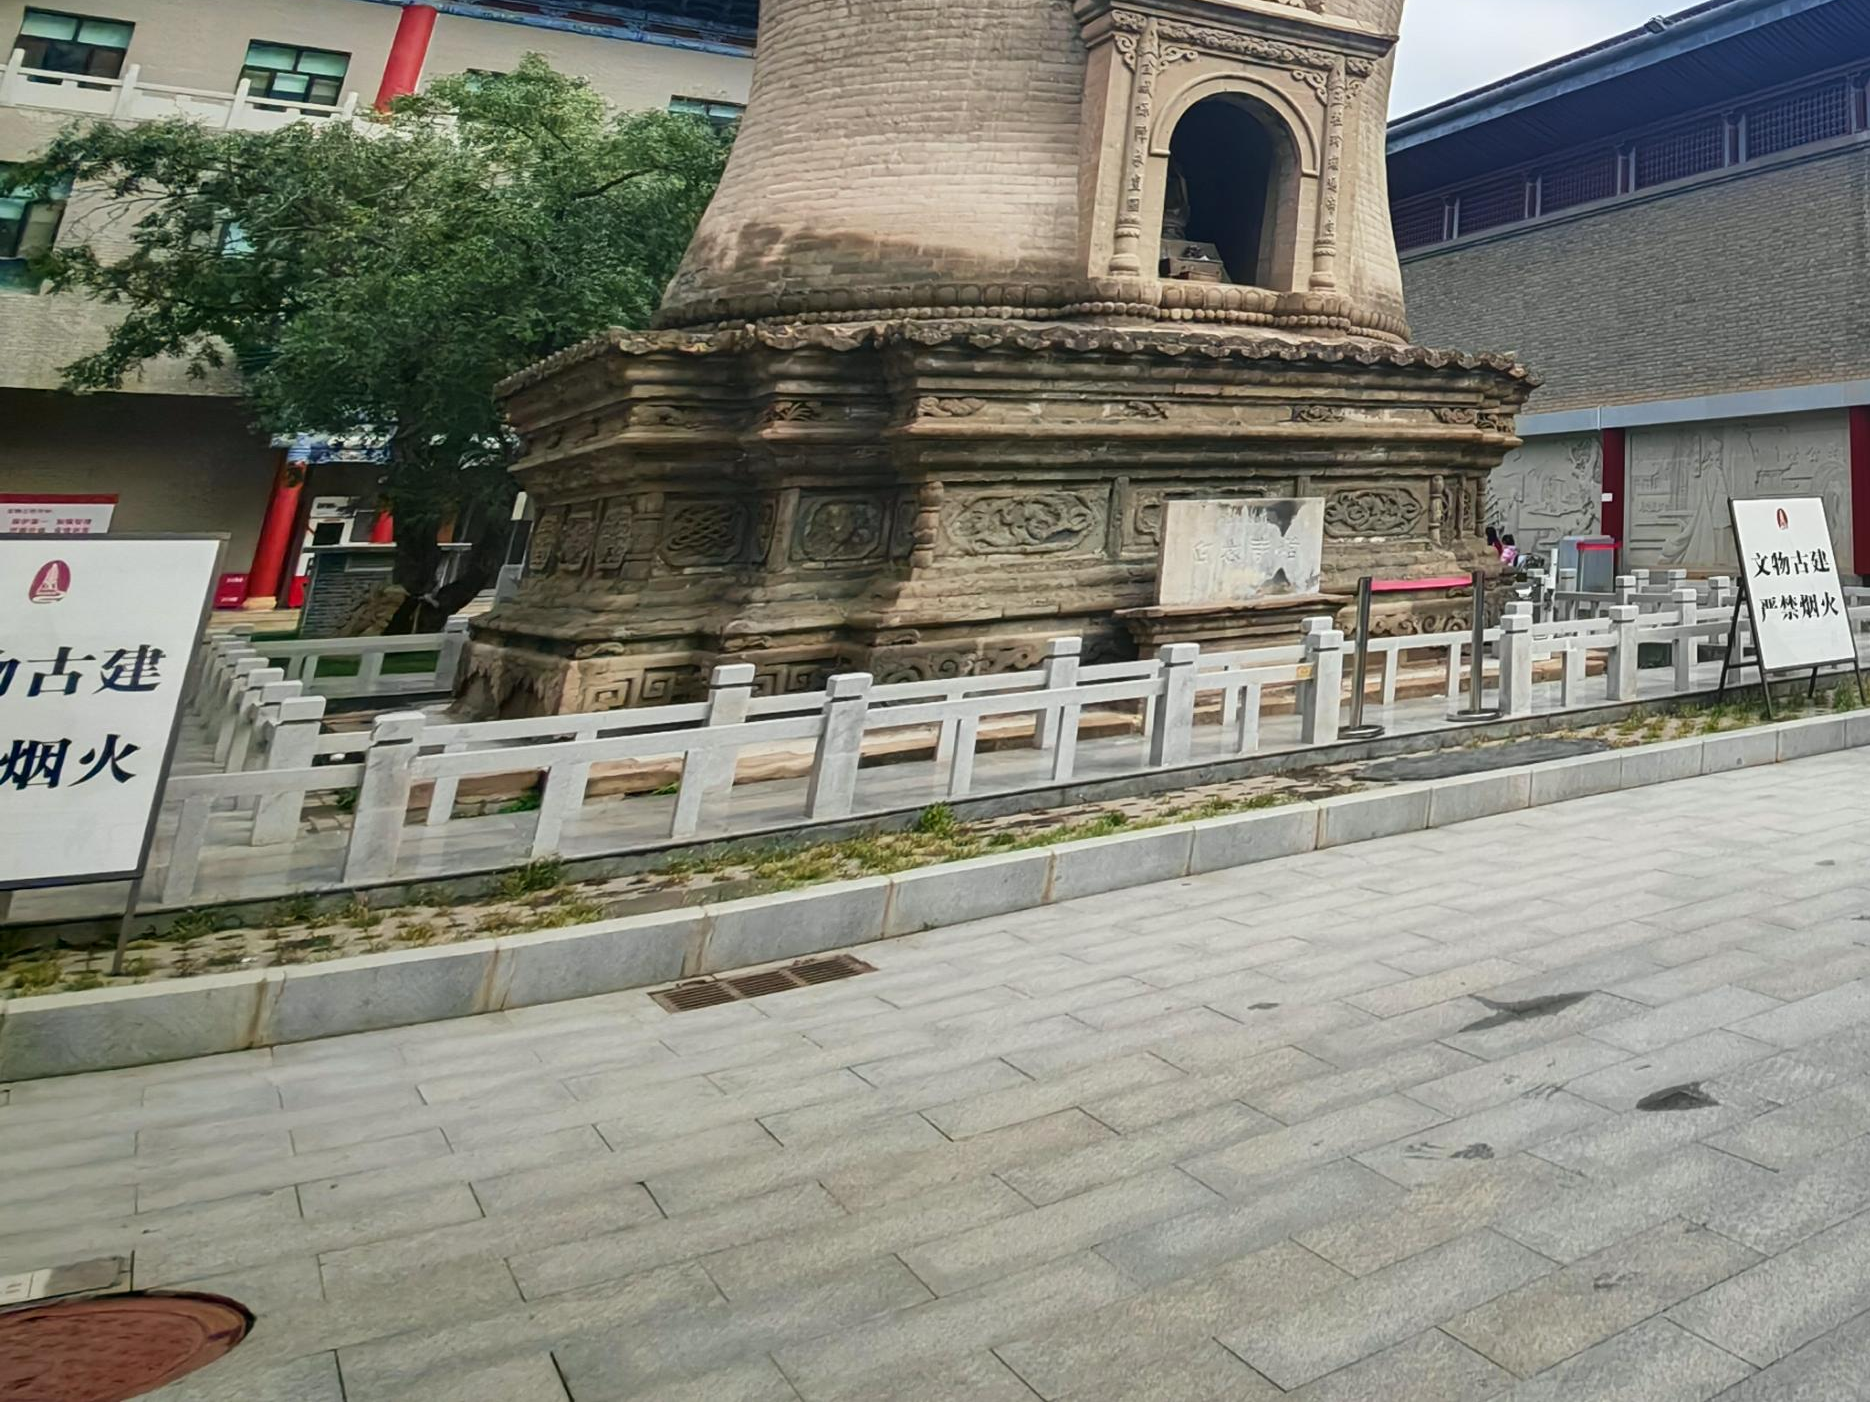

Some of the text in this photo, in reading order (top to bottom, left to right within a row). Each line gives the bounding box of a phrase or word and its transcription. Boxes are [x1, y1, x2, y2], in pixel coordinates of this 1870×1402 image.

[1751, 547, 1831, 578] 文物古建
[1760, 591, 1840, 623] 严禁烟火
[0, 734, 141, 791] 烟火
